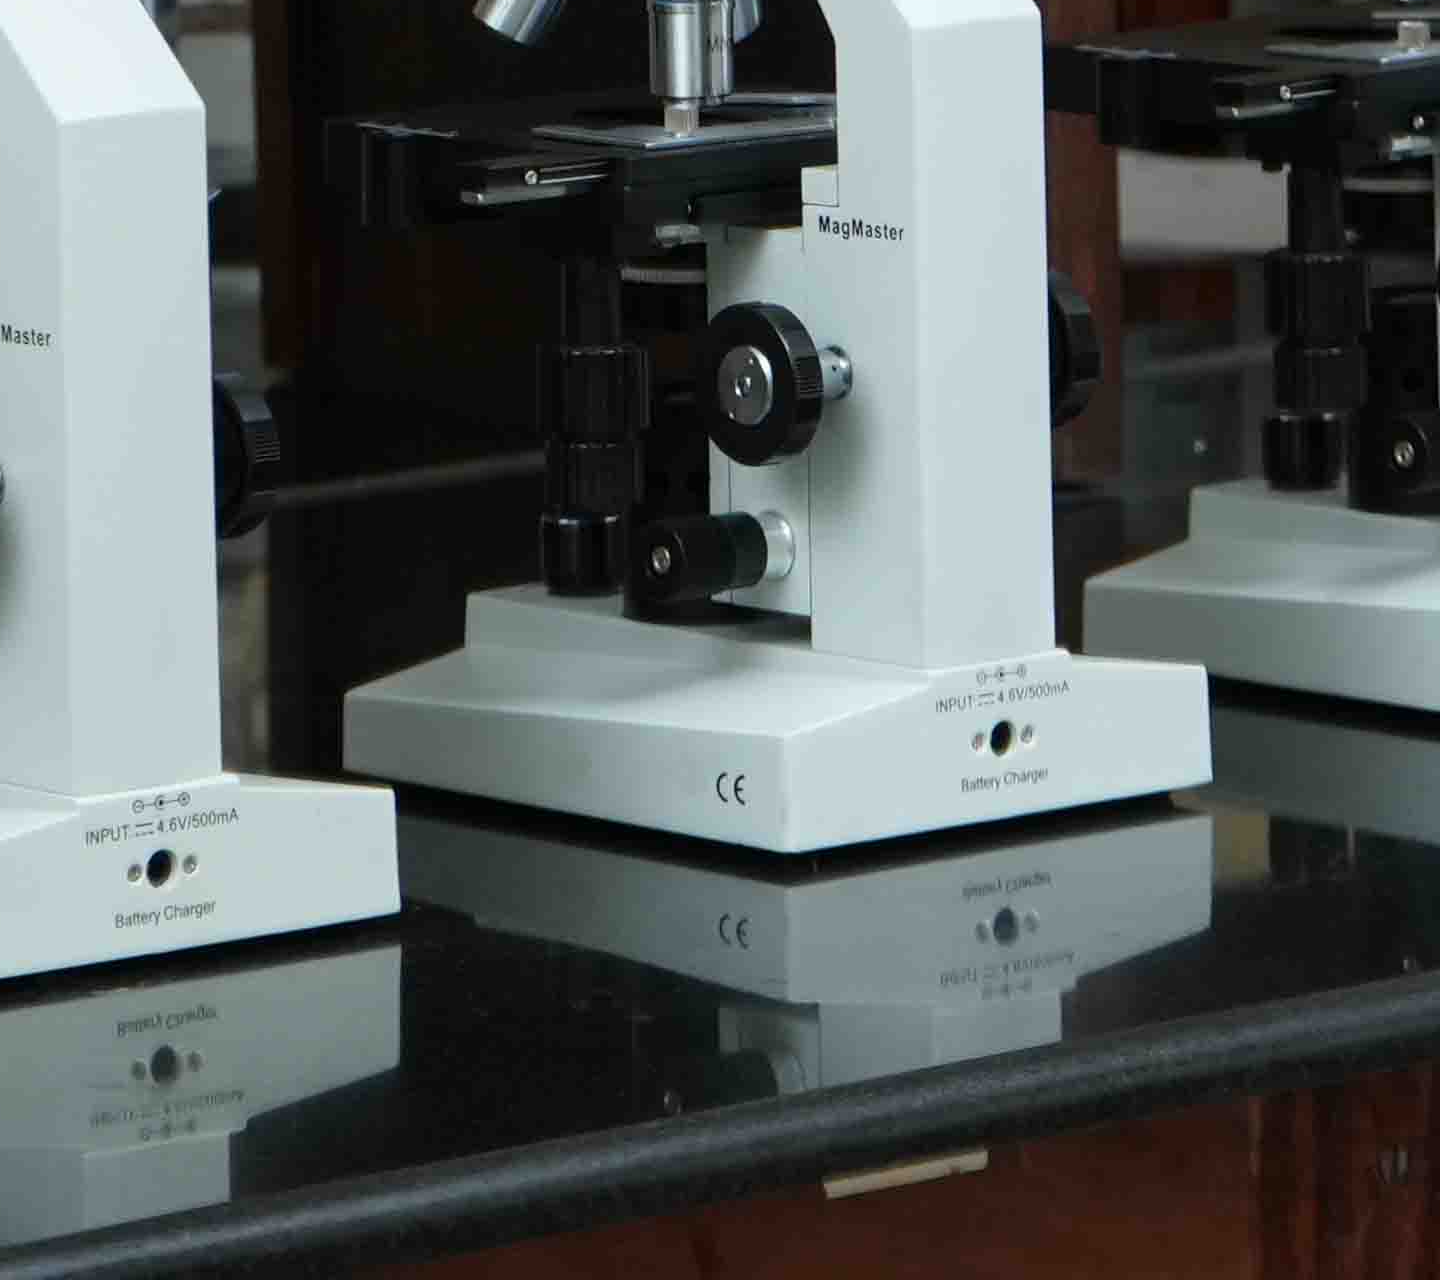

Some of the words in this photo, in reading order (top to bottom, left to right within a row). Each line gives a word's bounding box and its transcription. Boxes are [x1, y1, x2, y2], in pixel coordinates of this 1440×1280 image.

[818, 215, 904, 241] MagMaster
[935, 696, 973, 713] INPUT
[716, 772, 746, 806] CE
[961, 775, 1000, 792] Battery
[1003, 768, 1049, 785] Charger
[85, 824, 130, 846] INPUT
[157, 808, 240, 833] 4.6V/500mA
[114, 910, 161, 928] Battery
[163, 900, 217, 920] Charger
